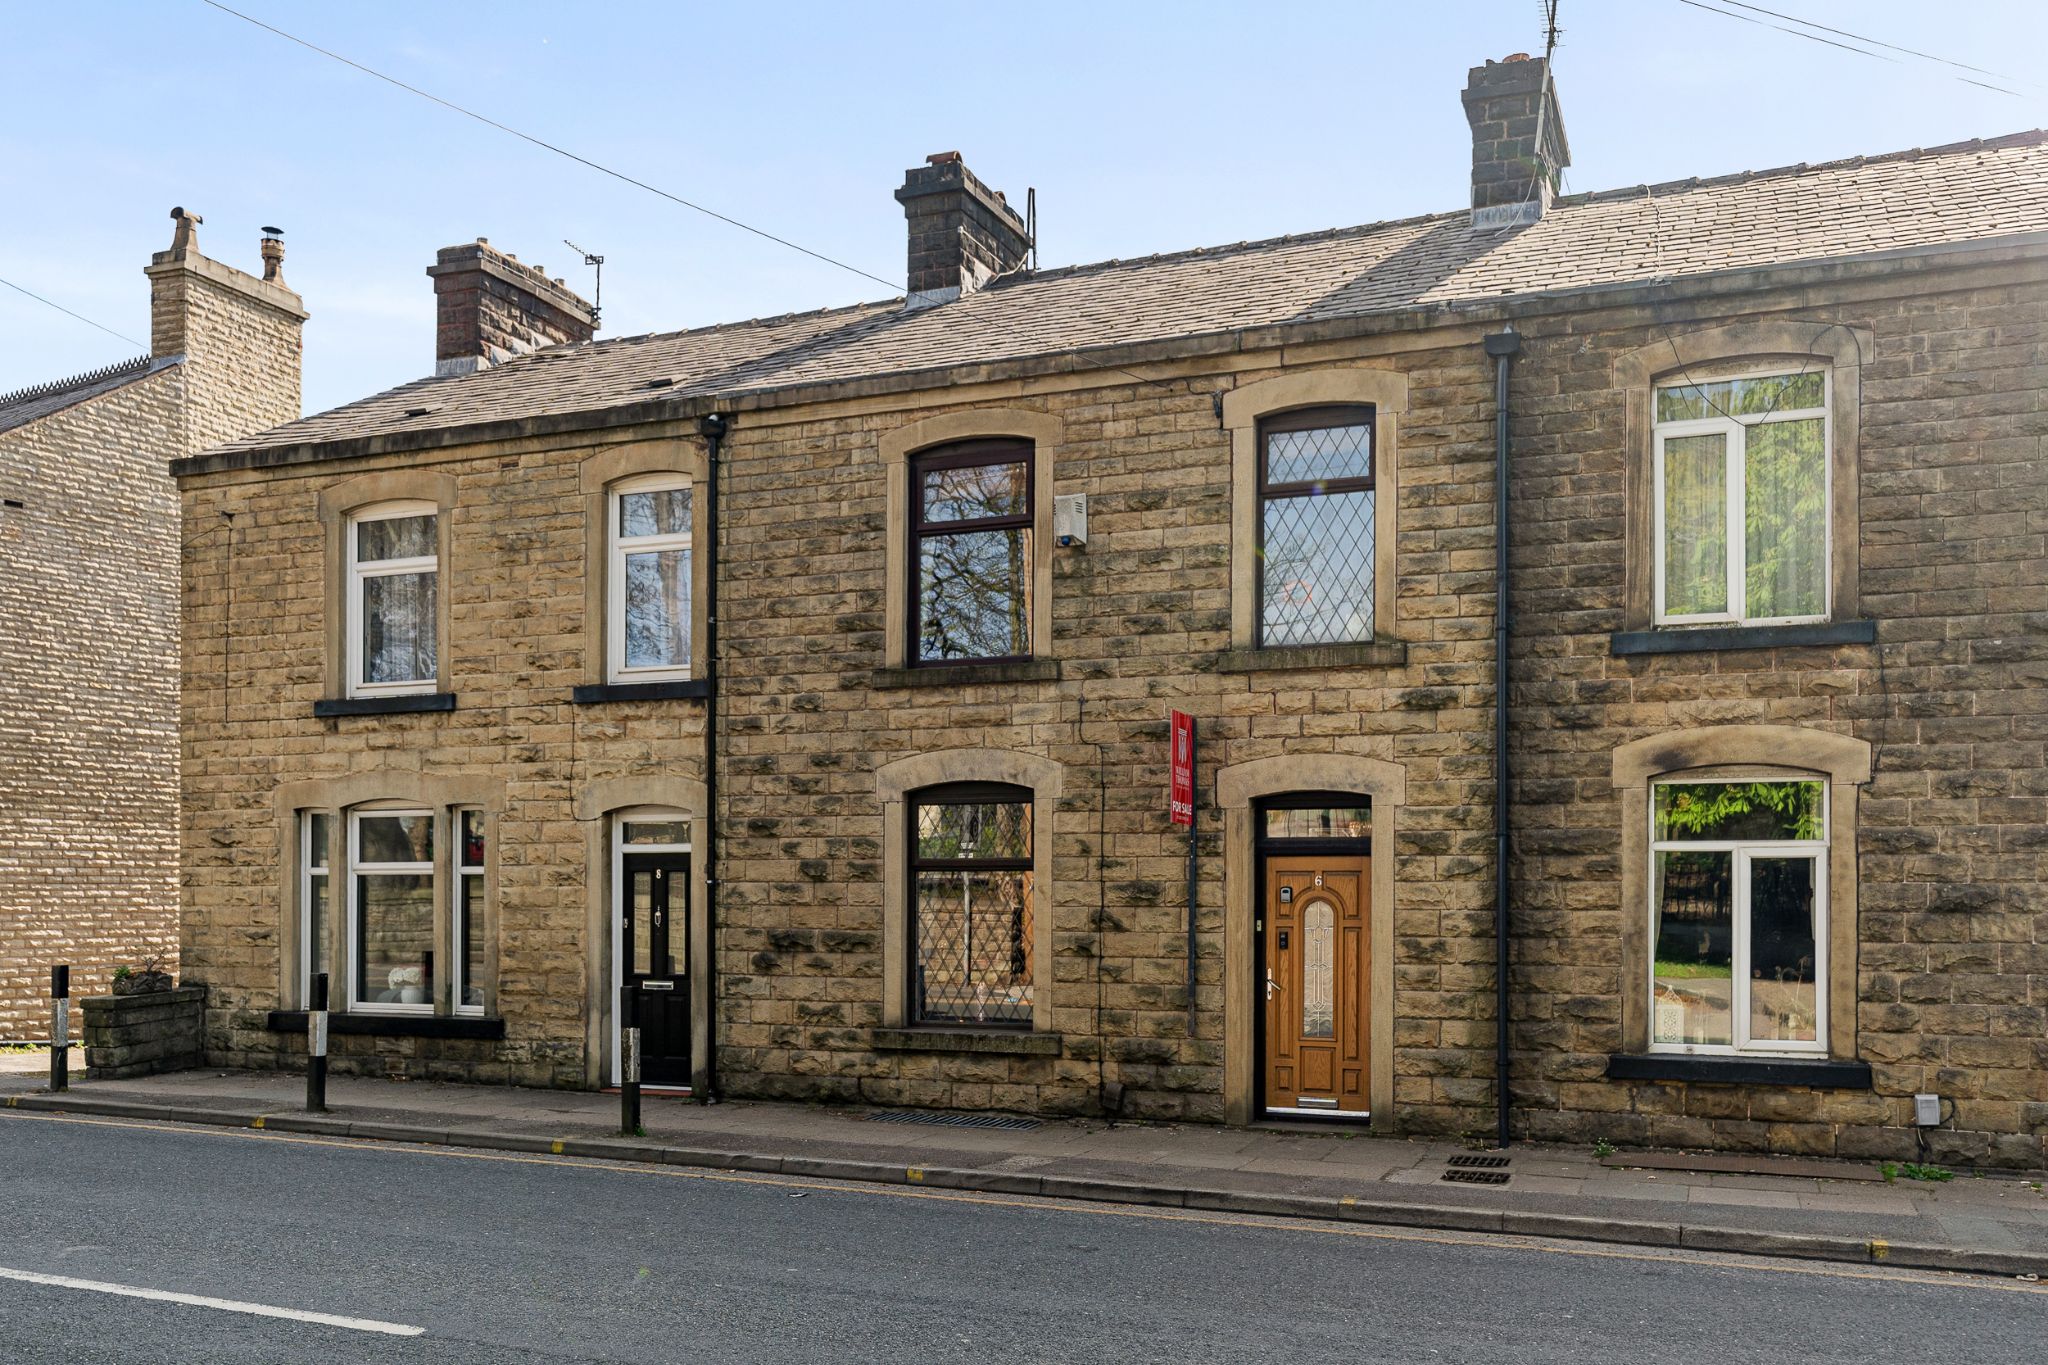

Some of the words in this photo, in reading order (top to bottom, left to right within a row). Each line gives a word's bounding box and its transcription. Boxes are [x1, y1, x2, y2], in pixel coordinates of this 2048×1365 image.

[1172, 800, 1181, 813] FOR
[1181, 802, 1192, 815] SALE
[656, 869, 661, 879] 8
[1315, 875, 1322, 886] 6
